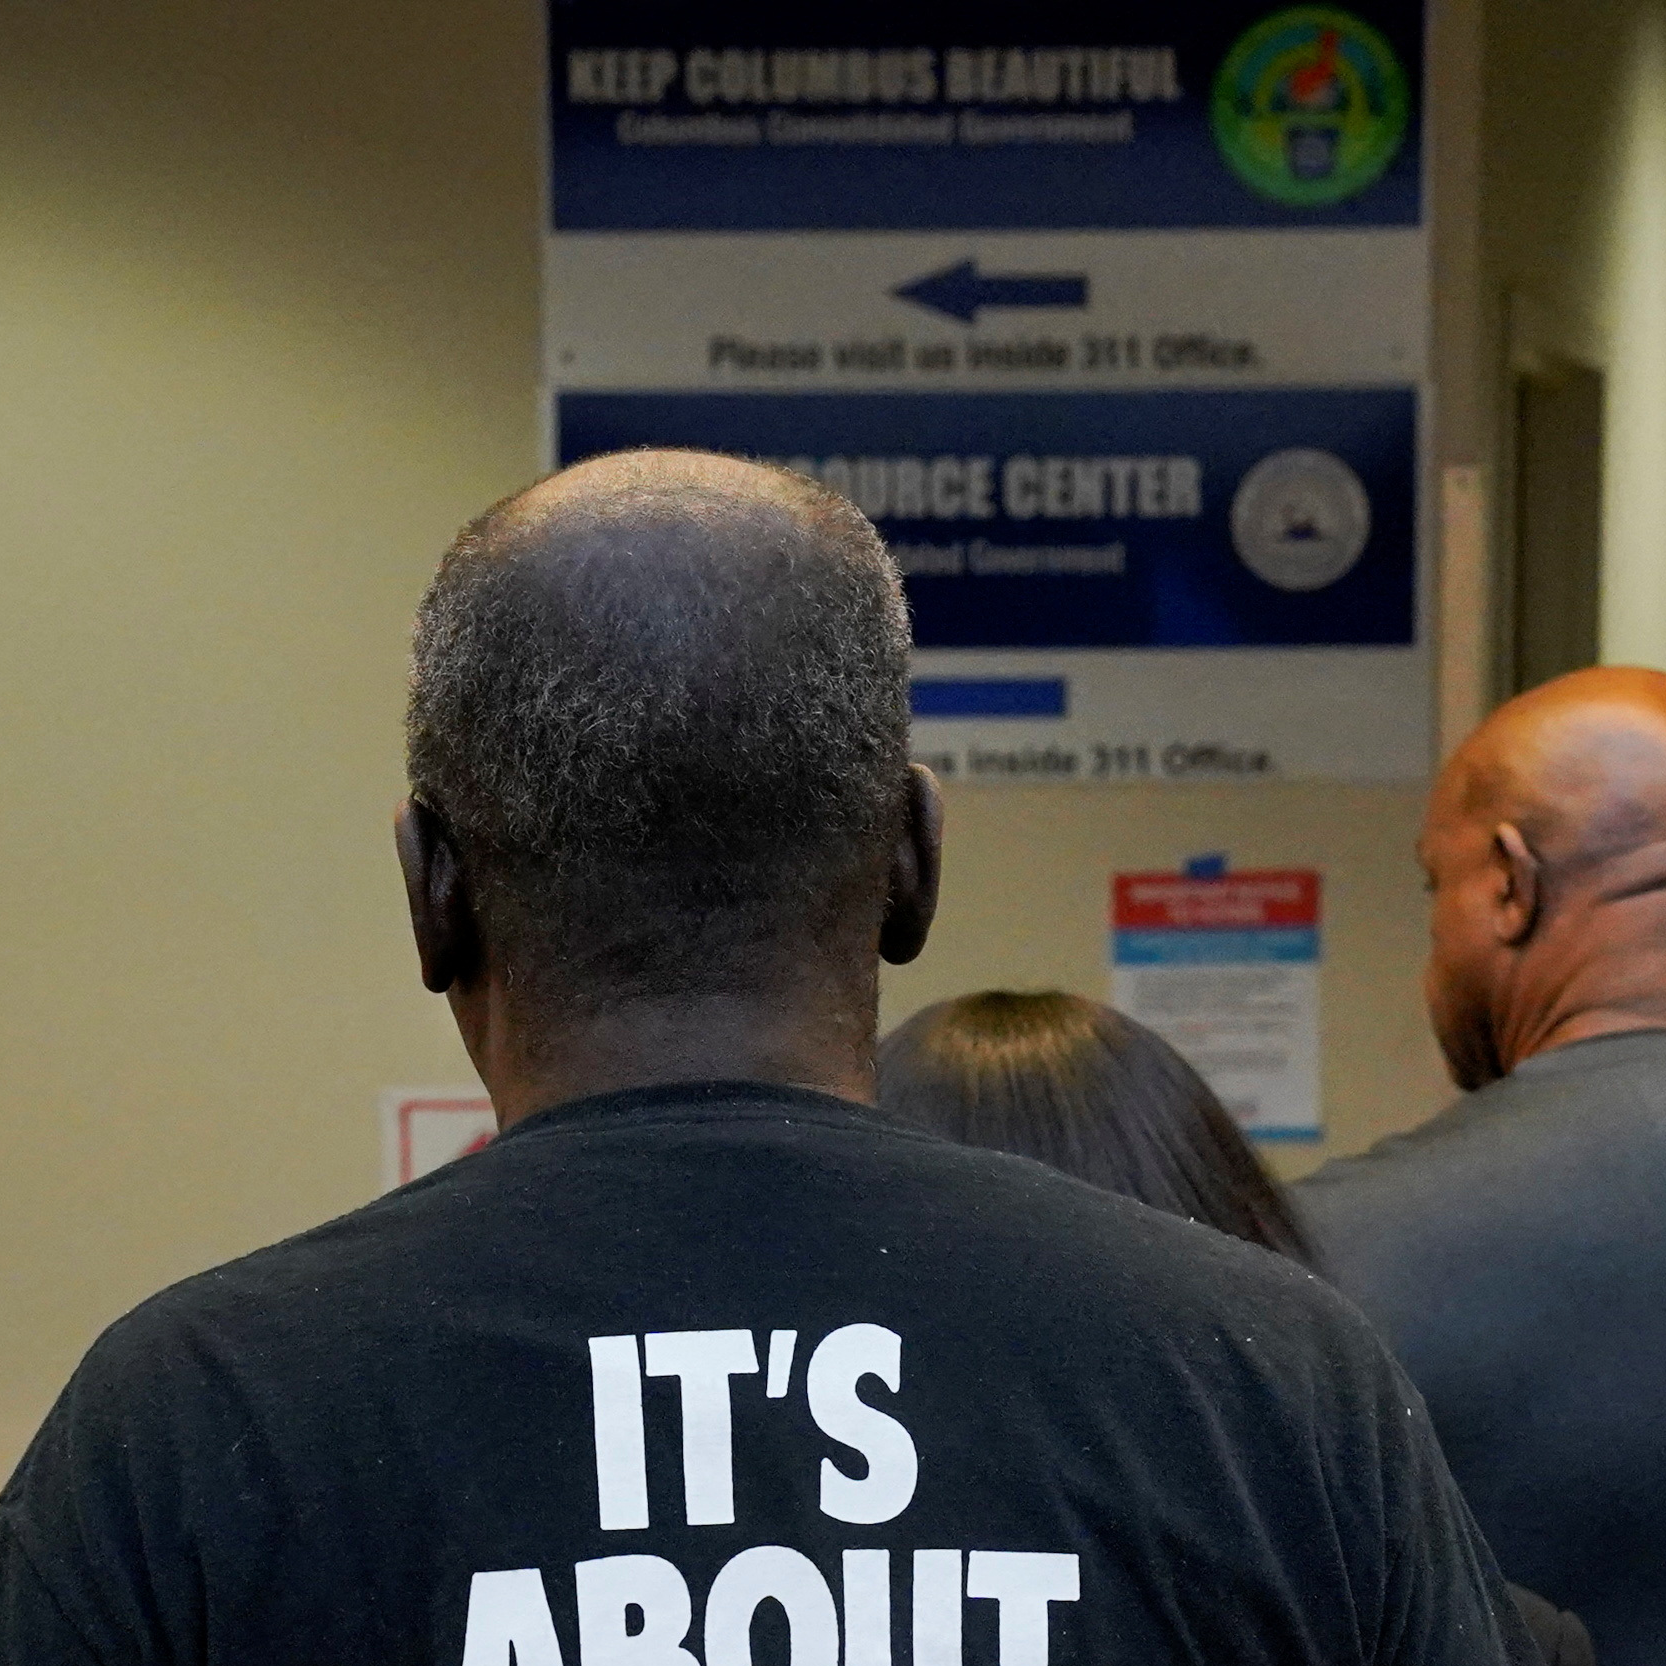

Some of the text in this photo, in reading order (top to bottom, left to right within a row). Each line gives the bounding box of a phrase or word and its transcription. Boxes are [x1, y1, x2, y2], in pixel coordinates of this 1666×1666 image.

[567, 46, 1183, 103] KEEP COLUMBUS BEAUTIFUL
[708, 335, 821, 371] Please
[834, 335, 906, 371] visit
[915, 343, 954, 371] us
[965, 338, 1071, 371] inside
[1079, 335, 1141, 371] 311
[1003, 455, 1201, 519] CENTER
[967, 743, 1077, 775] inside
[1093, 742, 1150, 775] 311
[588, 1321, 919, 1531] IT'S
